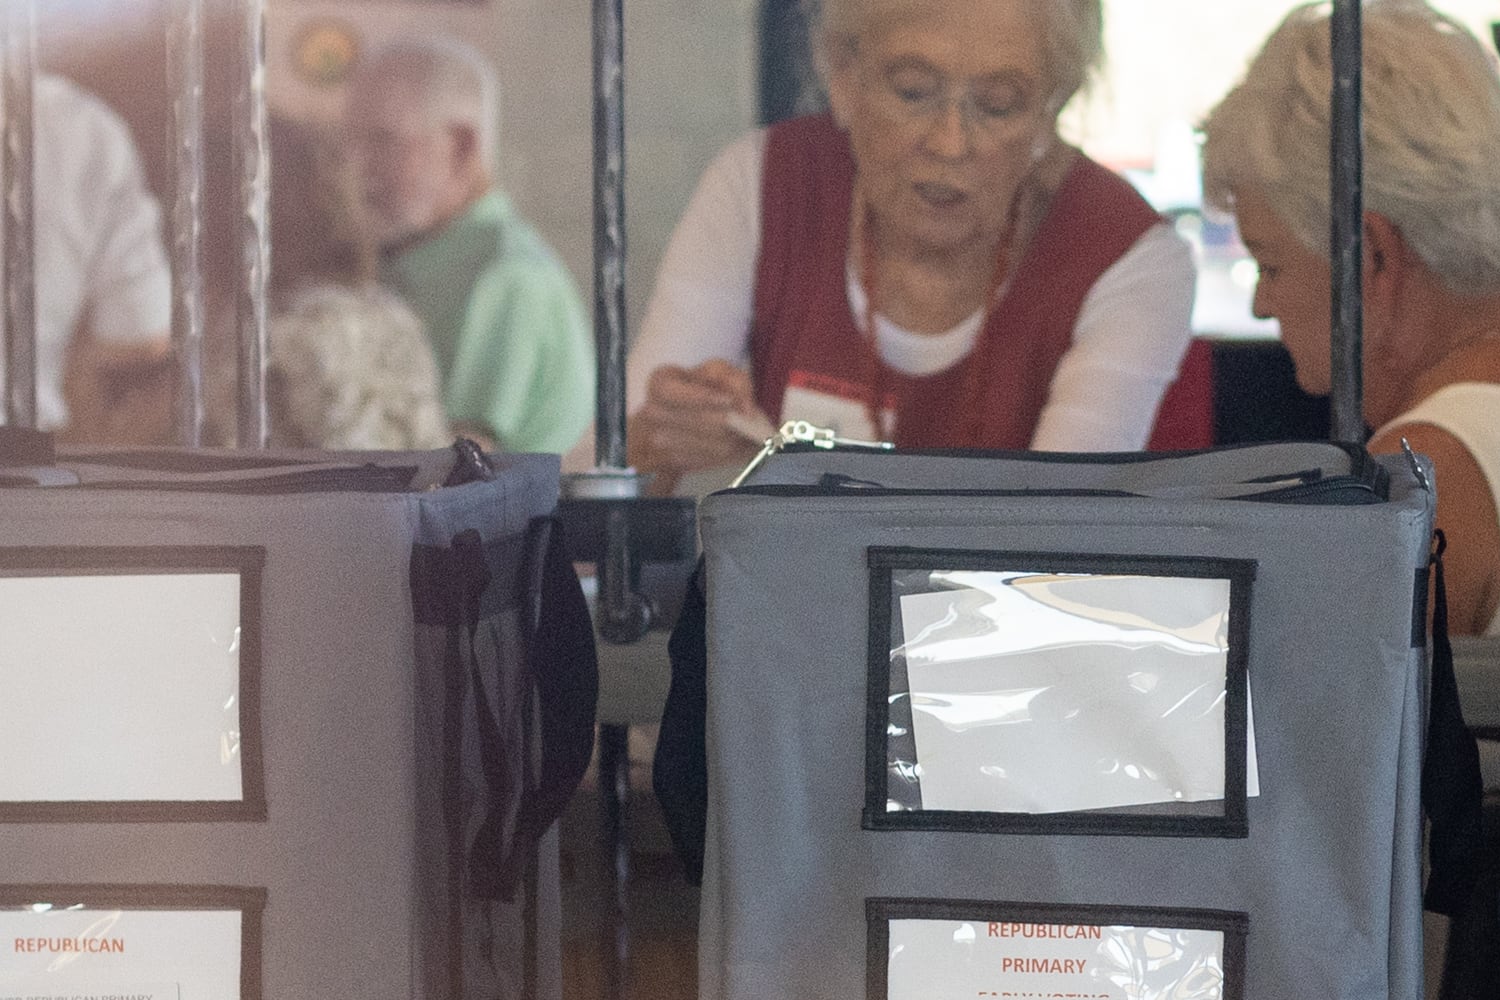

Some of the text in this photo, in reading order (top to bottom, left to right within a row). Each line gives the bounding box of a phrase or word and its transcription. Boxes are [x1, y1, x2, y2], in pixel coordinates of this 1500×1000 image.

[988, 921, 1101, 939] REPUBLICAN
[14, 938, 124, 953] REPUBLICAN
[1002, 957, 1086, 974] PRIMARY
